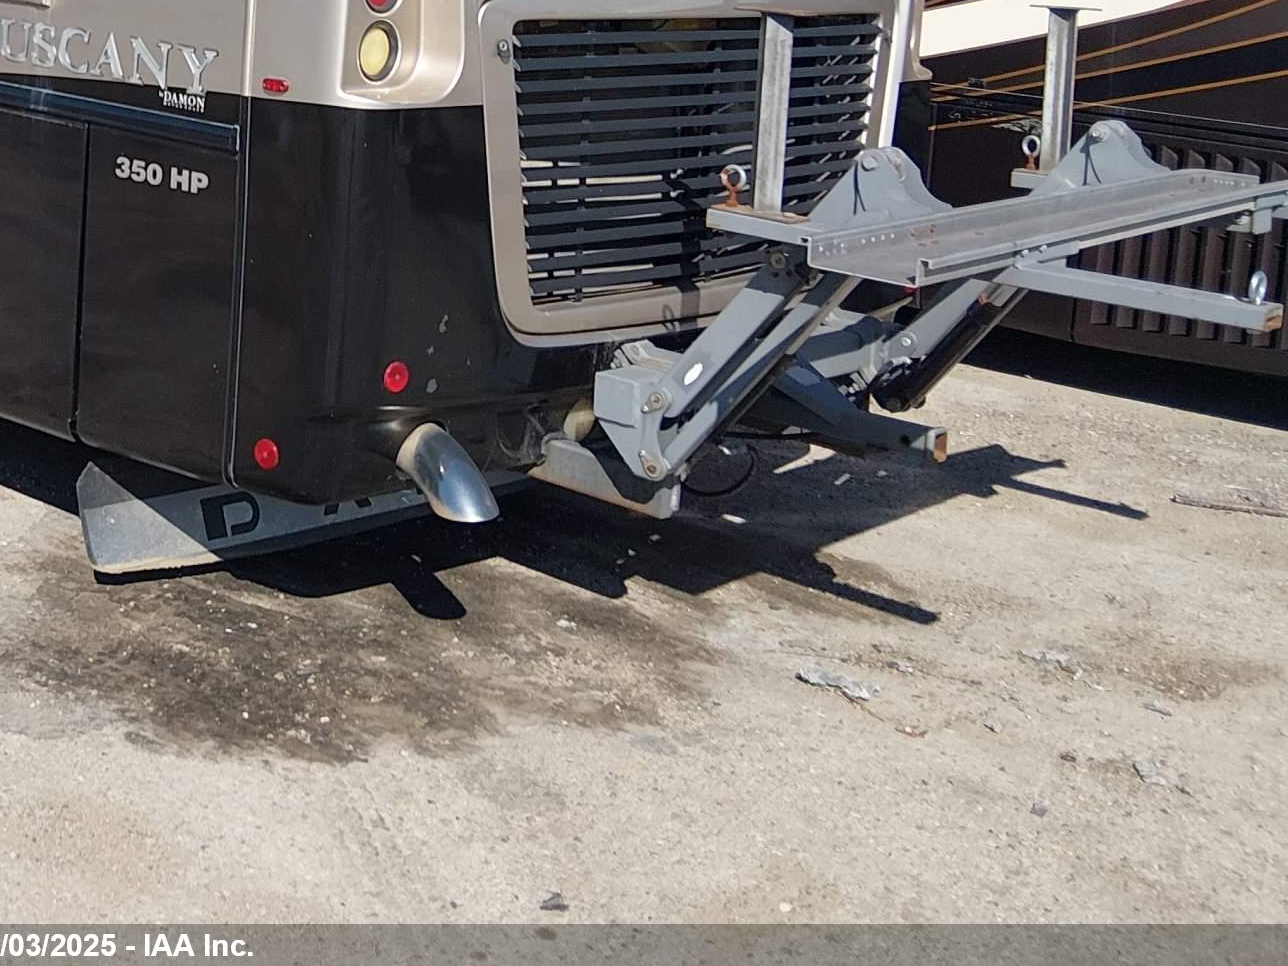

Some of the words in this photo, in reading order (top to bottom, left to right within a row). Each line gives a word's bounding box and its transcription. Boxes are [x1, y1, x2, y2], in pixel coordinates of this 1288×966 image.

[163, 90, 205, 109] DAMON
[114, 156, 163, 186] 350
[170, 166, 209, 194] HP
